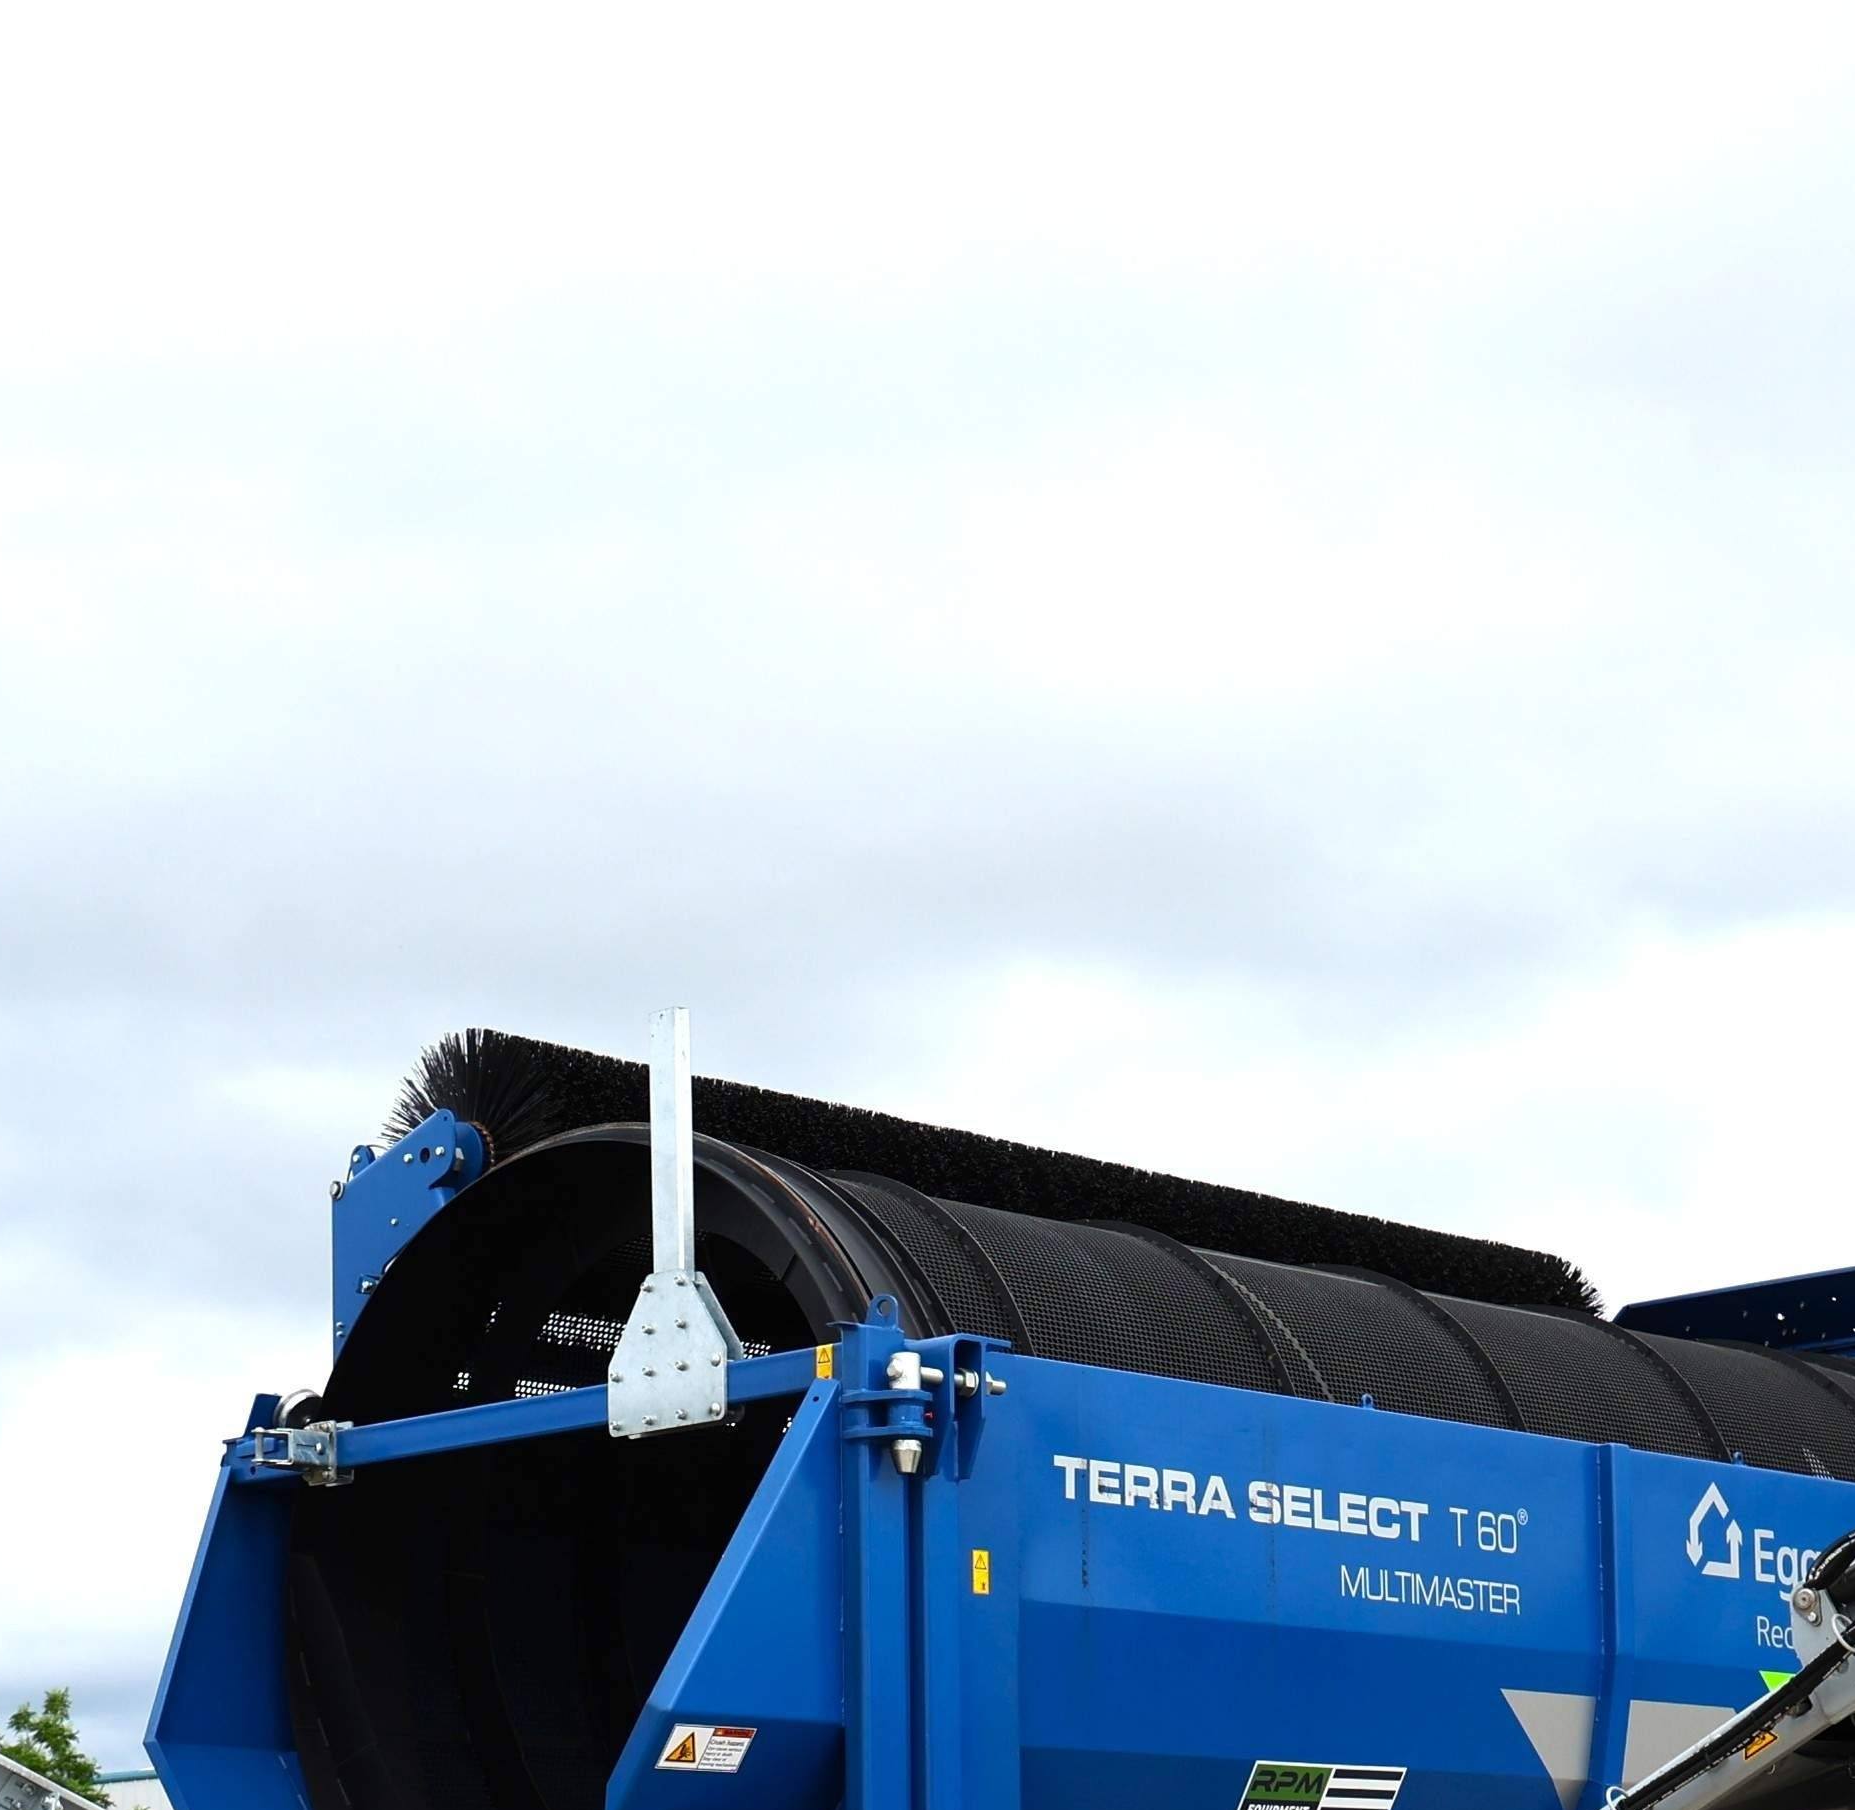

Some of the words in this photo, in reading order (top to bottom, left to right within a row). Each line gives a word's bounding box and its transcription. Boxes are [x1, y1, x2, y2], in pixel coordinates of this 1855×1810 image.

[1053, 1454, 1237, 1520] TERRA
[1248, 1480, 1429, 1542] SELECT
[1448, 1506, 1469, 1547] T
[1340, 1564, 1521, 1616] MULTIMASTER
[1250, 1769, 1324, 1795] RPM
